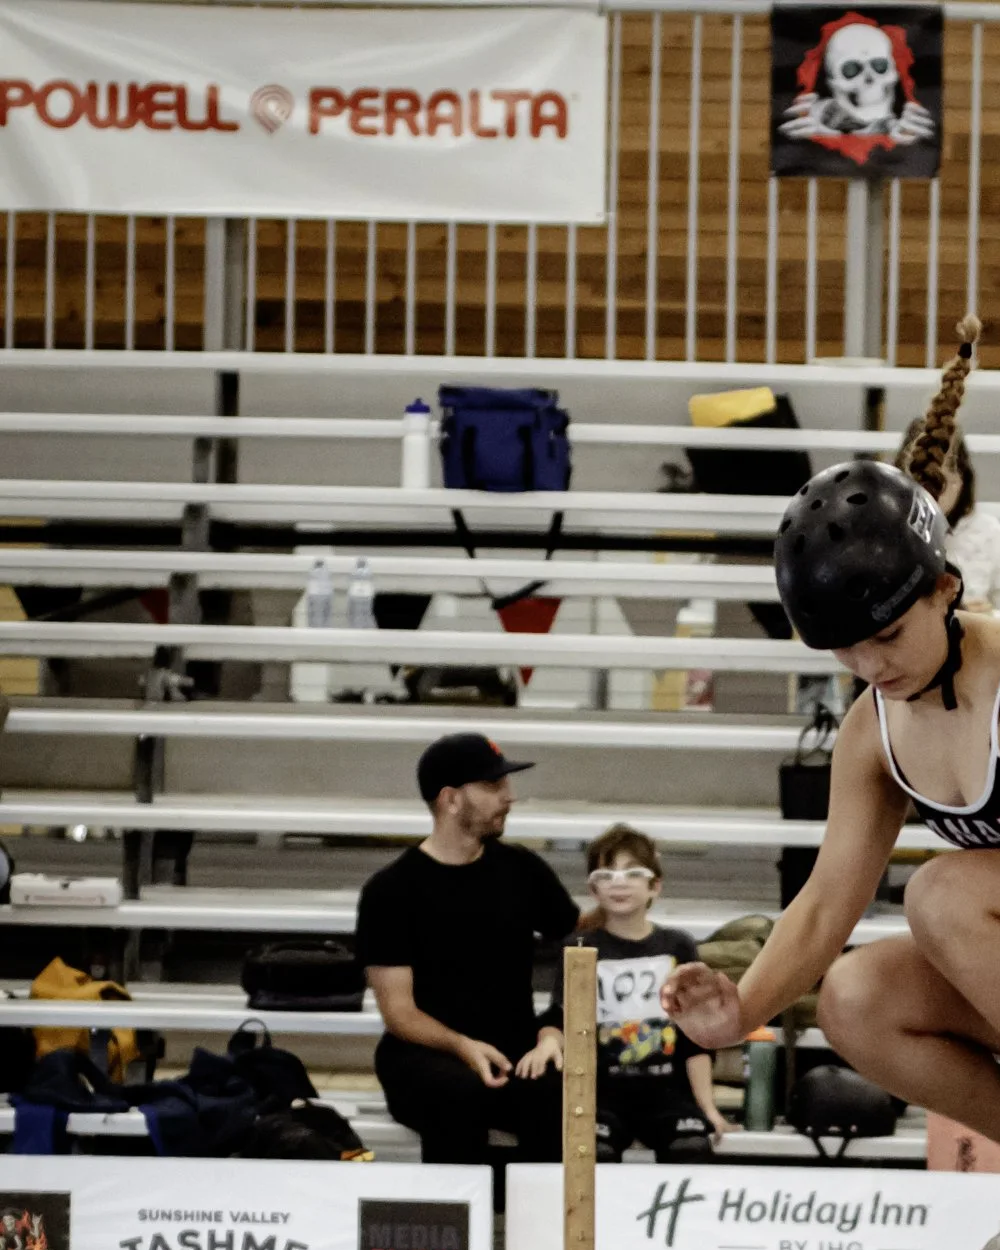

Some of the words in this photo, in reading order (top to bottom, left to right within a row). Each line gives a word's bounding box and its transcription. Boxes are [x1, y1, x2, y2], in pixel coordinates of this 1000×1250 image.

[0, 79, 240, 132] POWELL
[308, 87, 568, 139] PERALTA
[138, 1208, 223, 1223] SUNSHINE
[229, 1210, 290, 1224] VALLEY
[717, 1188, 861, 1233] Holiday
[869, 1191, 929, 1226] Inn
[368, 1223, 461, 1249] MEDIA
